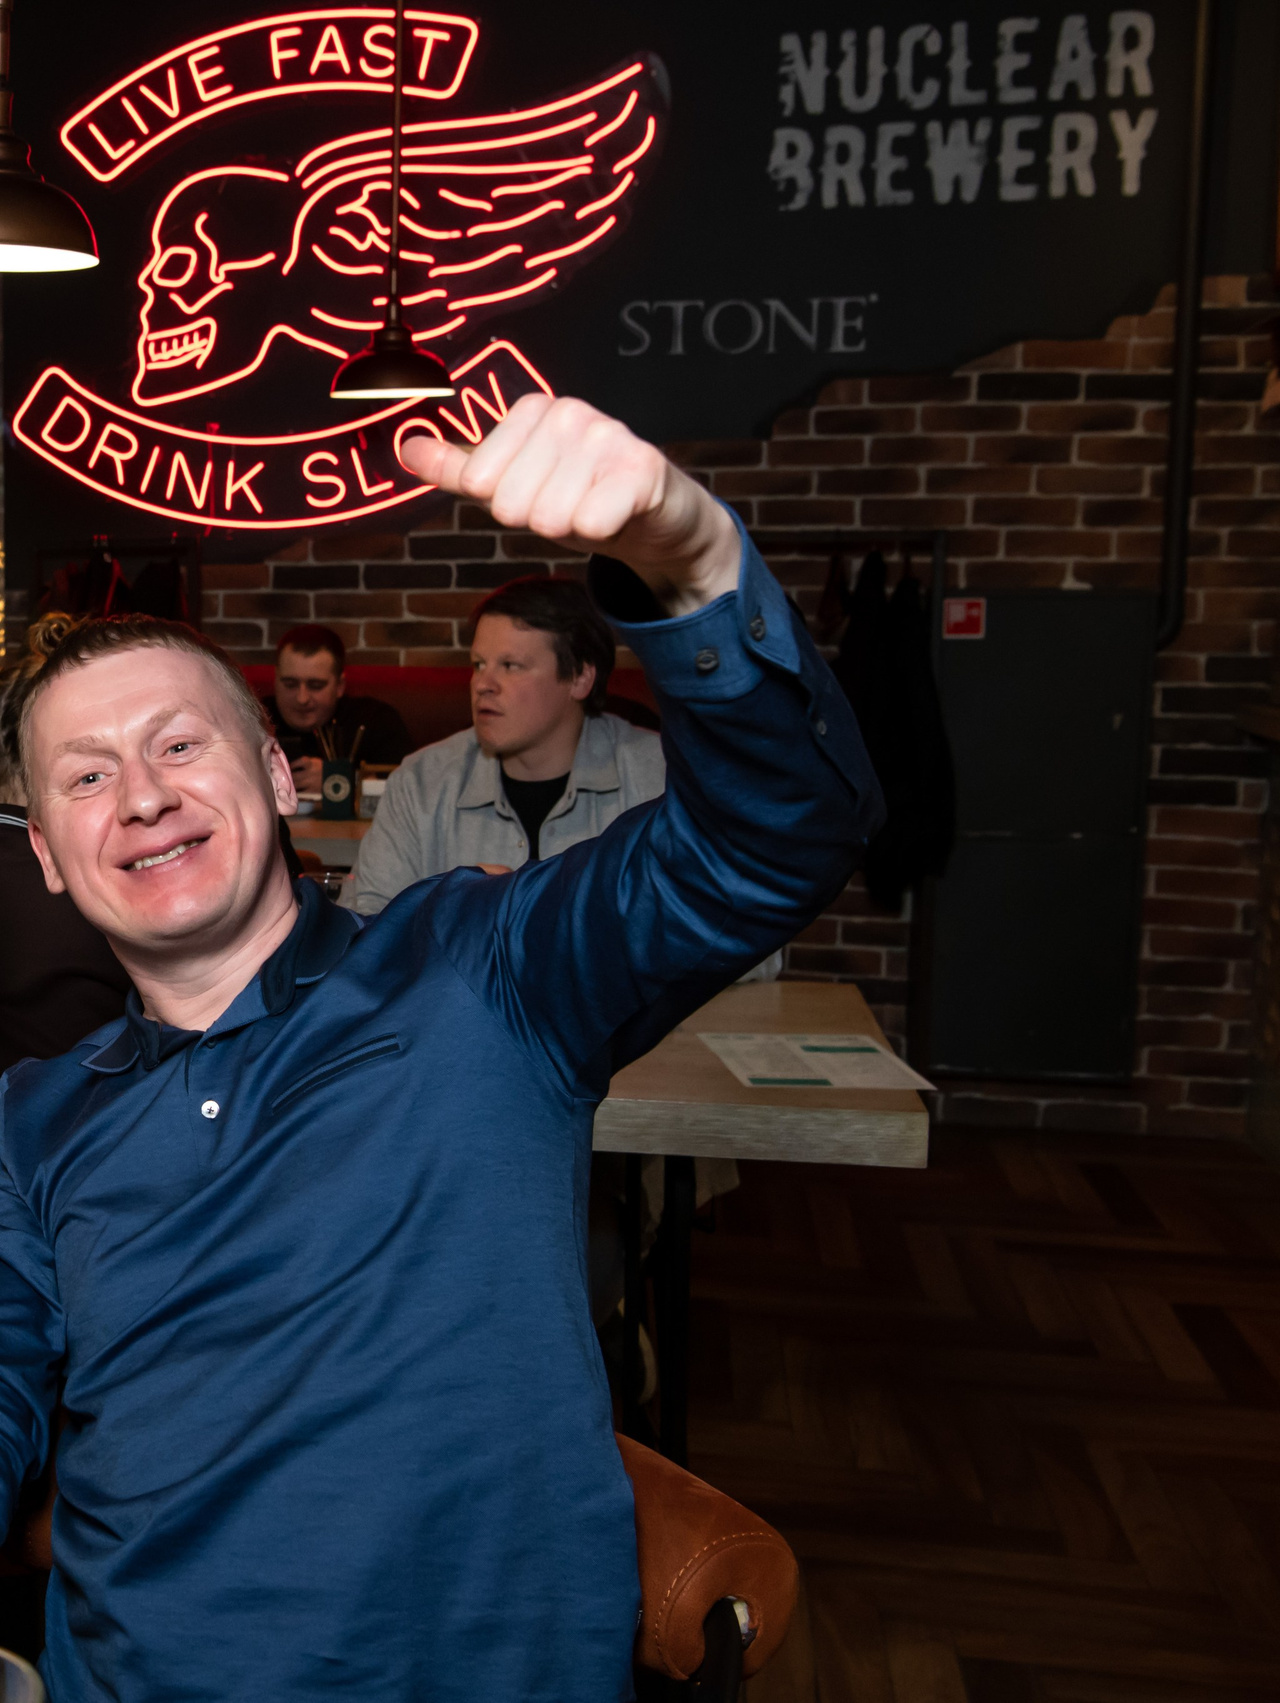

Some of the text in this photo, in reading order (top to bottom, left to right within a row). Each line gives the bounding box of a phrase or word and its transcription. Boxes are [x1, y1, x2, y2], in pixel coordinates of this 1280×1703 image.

[88, 25, 451, 160] LIVE FAST
[778, 10, 1156, 117] NUCLEAR
[767, 108, 1159, 211] BREWERY
[617, 296, 868, 356] STONE
[42, 372, 508, 514] DRINK SLOW
